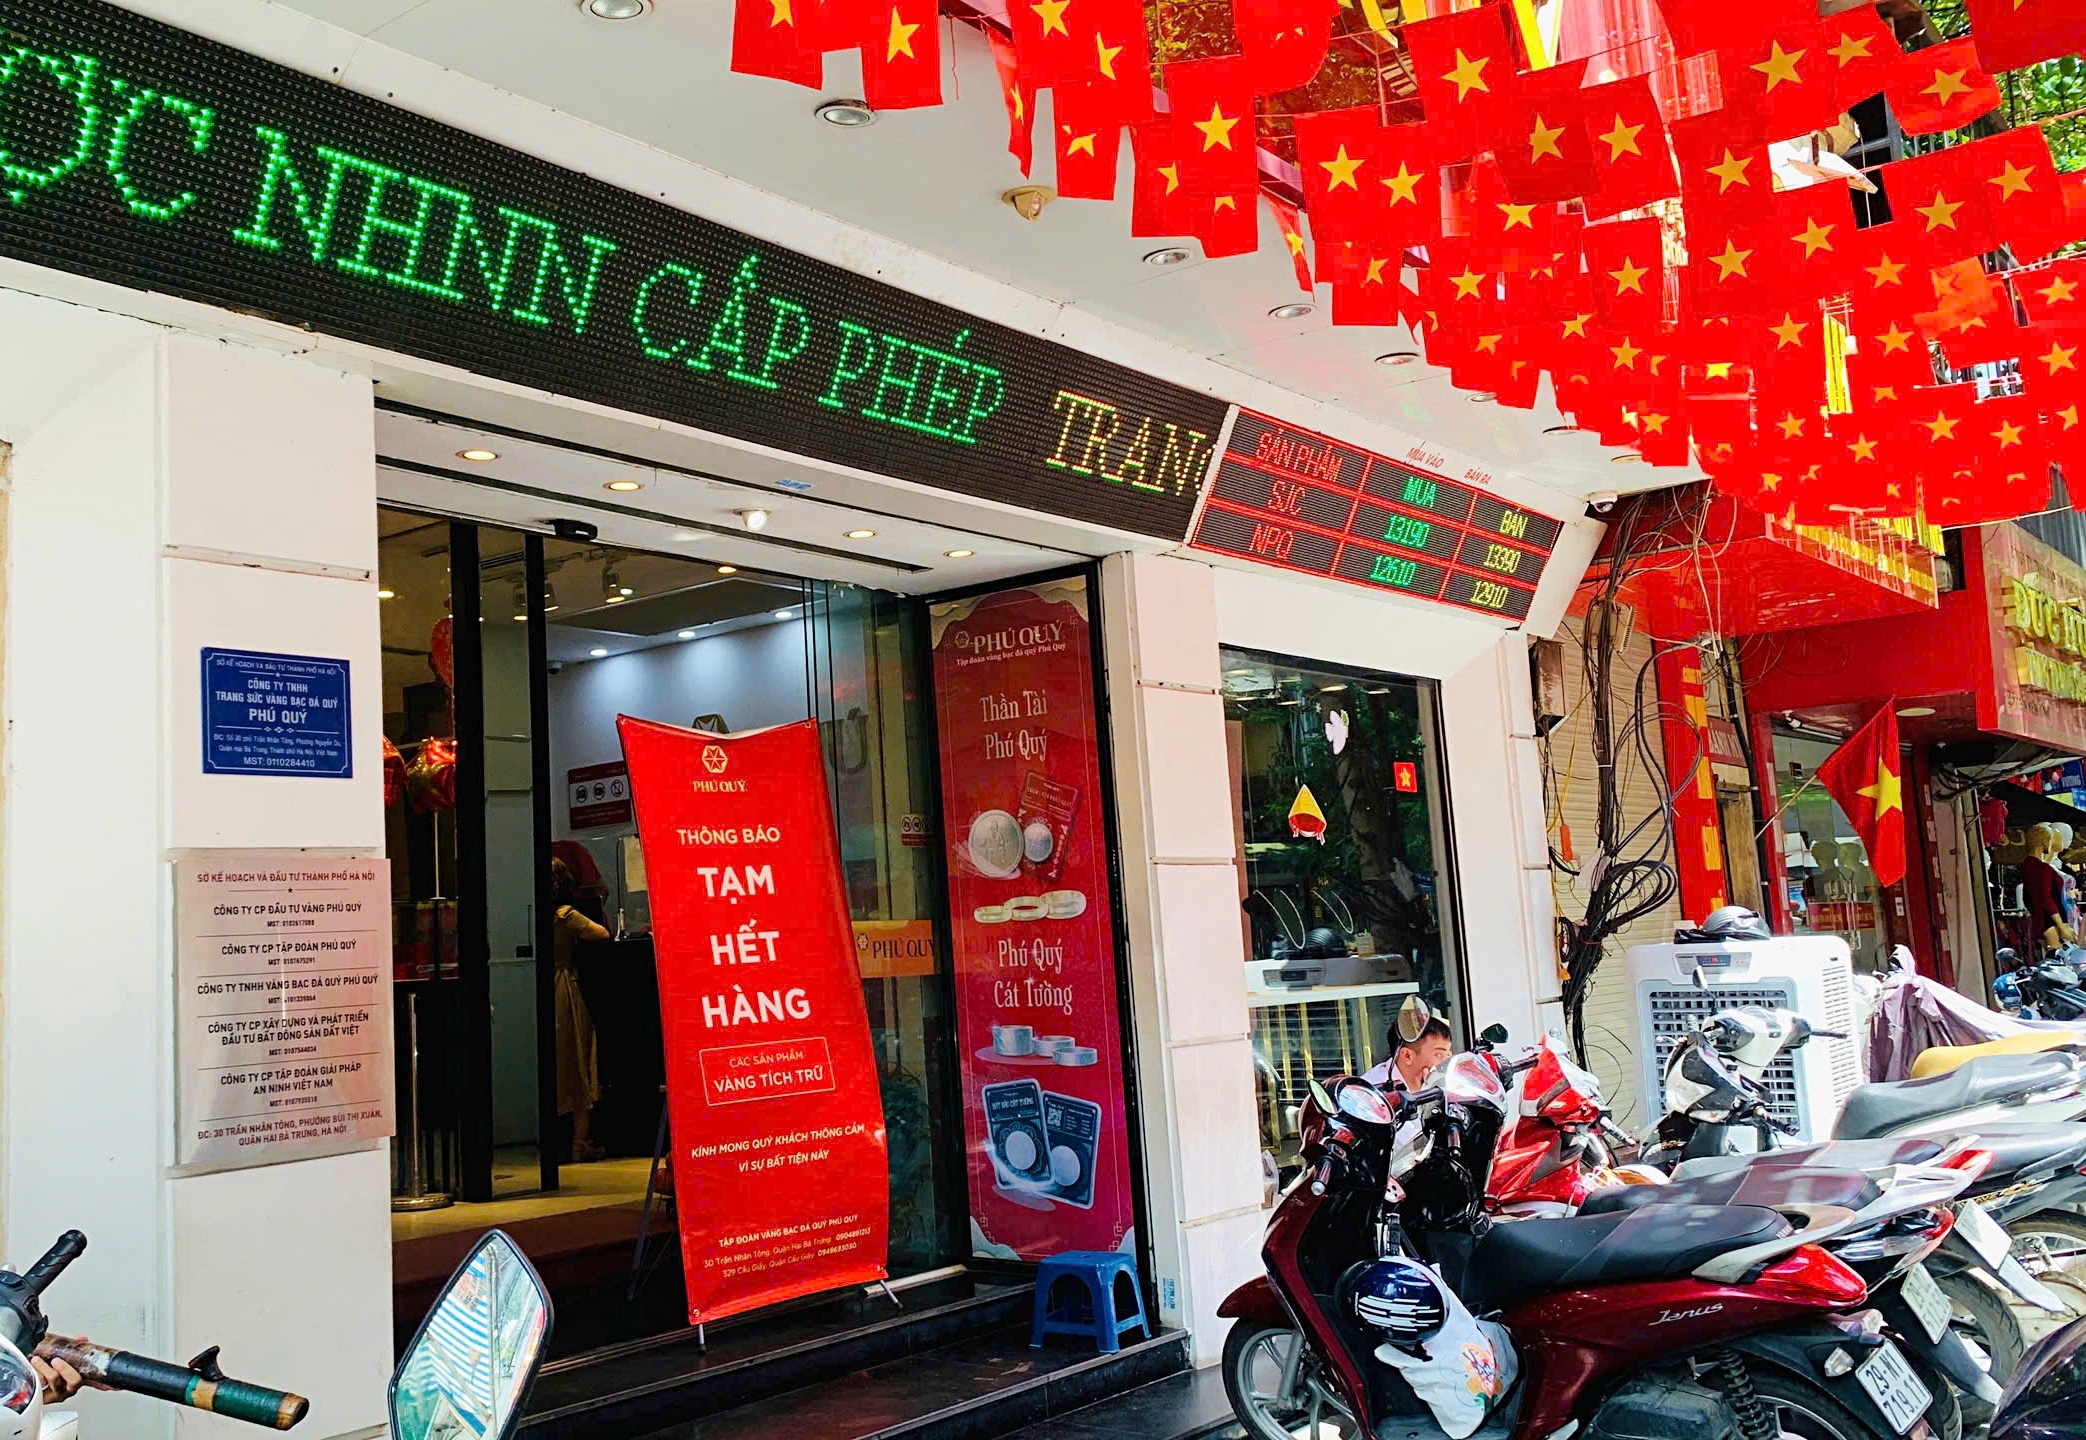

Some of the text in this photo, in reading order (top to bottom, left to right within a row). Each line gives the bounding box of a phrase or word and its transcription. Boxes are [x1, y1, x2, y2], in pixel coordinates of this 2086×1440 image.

[232, 125, 617, 334] NHNN
[633, 252, 811, 392] CẤP
[816, 328, 1006, 446] PHÉP
[1254, 430, 1344, 483] SẢN PHẨM
[1426, 452, 1445, 469] VÀO
[1479, 472, 1492, 485] RA
[1266, 479, 1308, 516] SJC
[1402, 474, 1439, 509] MUA
[1383, 513, 1431, 550] 13190
[1499, 506, 1529, 539] BÁN
[1249, 522, 1294, 561] NPQ
[1486, 543, 1521, 574] 13390
[1369, 555, 1417, 588] 12610
[1470, 579, 1509, 610] 12910
[973, 620, 1063, 654] PHÚ QUÝ
[1052, 642, 1066, 651] Quý
[248, 677, 308, 692] CÔNG TY TNHH
[216, 691, 338, 708] TRANG SỨC VÀNG BẠC ĐÁ QUÝ
[980, 689, 1047, 722] Thần Tài
[249, 707, 307, 724] PHÚ QUÝ
[984, 728, 1047, 761] Phú Quý
[244, 757, 314, 767] MST: 0110284410
[693, 779, 746, 792] PHÚ QUÝ
[677, 824, 780, 846] THÔNG BÁO
[697, 864, 774, 904] TẠM
[214, 901, 361, 915] CÔNG TY CP ĐẦU TƯ VÀNG PHÚ QUÝ
[222, 939, 356, 954] CÔNG TY CP TẬP ĐOÀN PHÚ QUÝ
[710, 918, 780, 966] HẾT
[872, 937, 903, 959] PHÚ
[998, 938, 1063, 973] Phú Quý
[198, 983, 222, 994] CÔNG
[226, 984, 236, 993] TY
[239, 983, 263, 992] TNHH
[312, 976, 323, 987] ĐÁ
[325, 977, 341, 987] QUÝ
[344, 976, 360, 985] PHÚ
[362, 973, 377, 985] QUÝ
[702, 984, 811, 1028] HÀNG
[994, 978, 1072, 1015] Cát Tường
[208, 1022, 233, 1033] CÔNG
[249, 1022, 260, 1030] CP
[263, 1019, 279, 1029] XÂY
[309, 1015, 319, 1026] VÀ
[321, 1012, 342, 1024] PHÁT
[345, 1009, 368, 1022] TRIỂN
[222, 1033, 240, 1045] ĐẦU
[243, 1034, 255, 1043] TƯ
[257, 1028, 274, 1042] BẤT
[304, 1026, 321, 1038] SẢN
[323, 1023, 339, 1037] ĐẤT
[729, 1048, 803, 1068] CÁC SẢN PHẨM
[221, 1073, 245, 1085] CÔNG
[248, 1074, 259, 1083] TY
[262, 1072, 273, 1081] CP
[275, 1071, 291, 1081] TẬP
[295, 1067, 318, 1078] ĐOÀN
[339, 1063, 361, 1073] PHÁP
[714, 1065, 823, 1093] VÀNG TÍCH TRỮ
[253, 1085, 266, 1094] AN
[269, 1082, 290, 1093] NINH
[314, 1079, 332, 1089] NAM
[214, 1128, 223, 1138] 30
[250, 1121, 271, 1133] NHÂN
[264, 1134, 276, 1142] HAI
[692, 1123, 865, 1159] KÍNH MONG QUÝ KHÁCH THÔNG CẢM
[739, 1150, 829, 1173] VÌ SỰ BẤT TIỆN NÀY
[1648, 1303, 1723, 1325] Janus
[1883, 1374, 1927, 1429] 719.11
